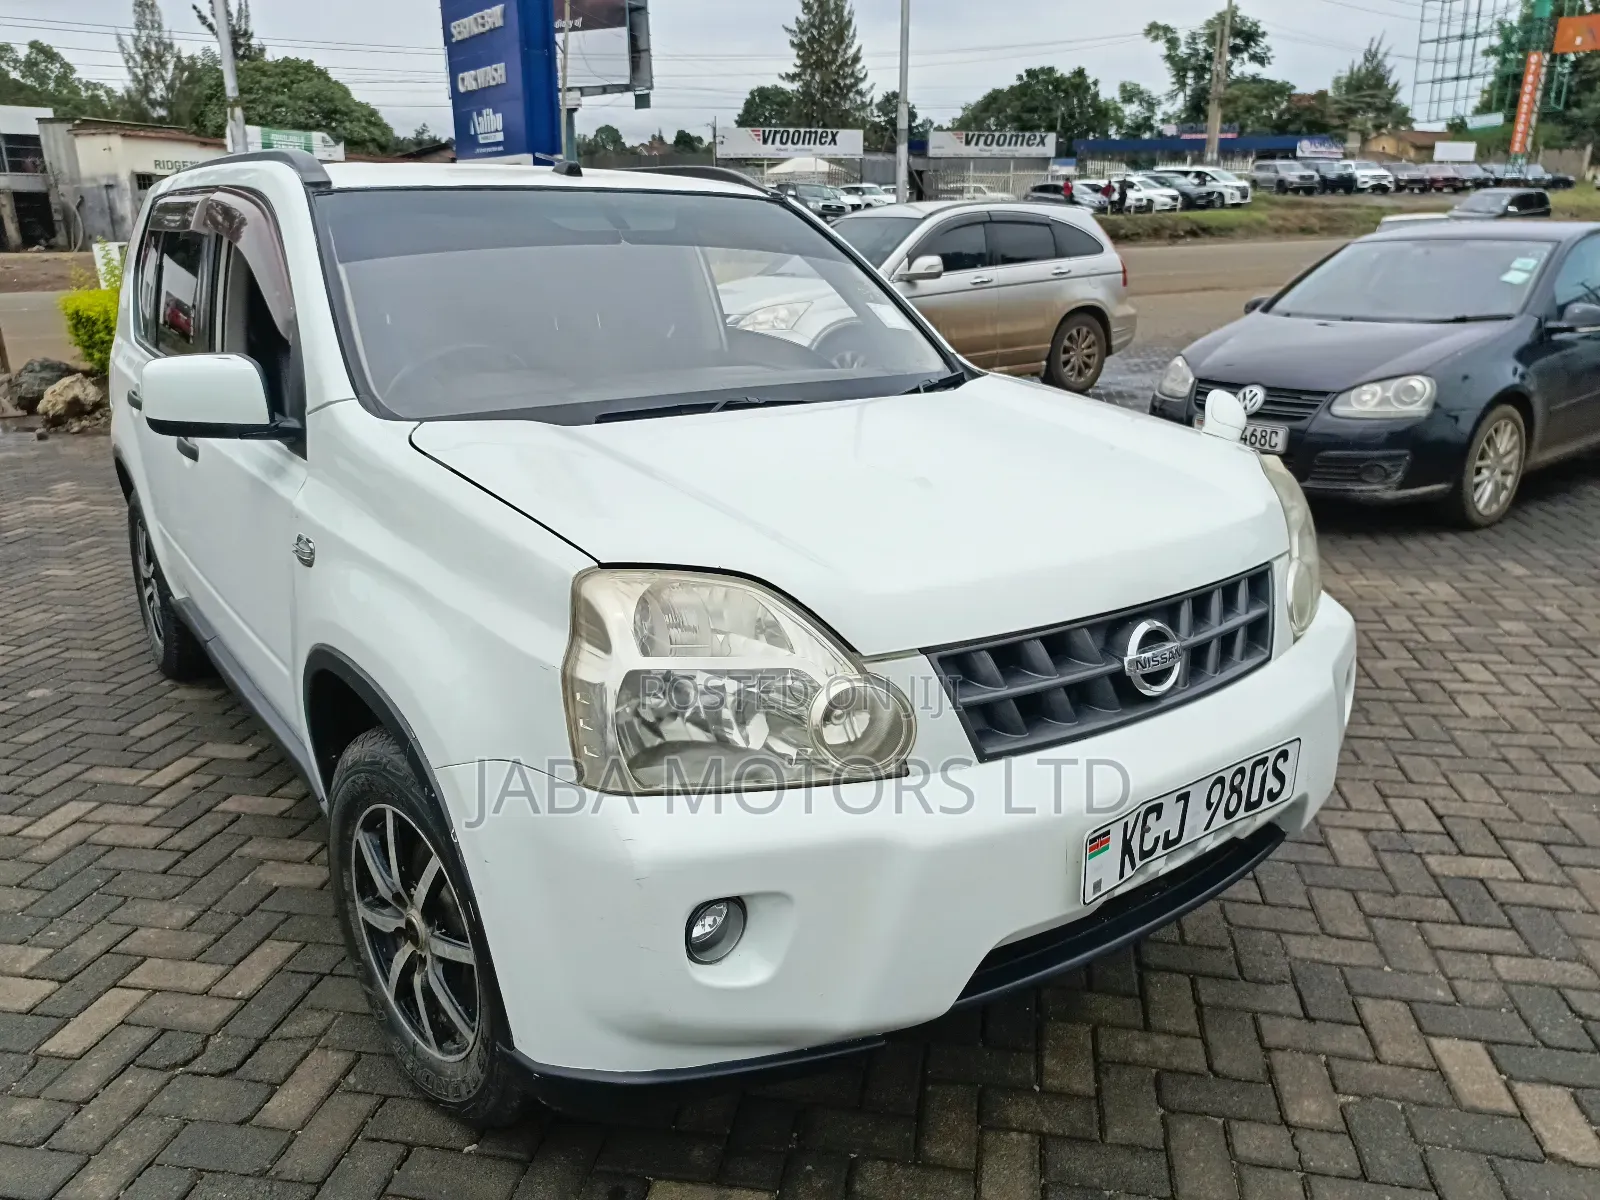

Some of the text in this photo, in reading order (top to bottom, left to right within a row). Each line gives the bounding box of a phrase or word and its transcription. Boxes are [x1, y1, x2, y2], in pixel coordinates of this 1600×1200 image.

[477, 62, 507, 88] WASH
[761, 129, 839, 146] vroomex
[964, 132, 1048, 147] vroomex
[1240, 427, 1279, 449] 468C
[1136, 645, 1182, 671] NISSAN
[1118, 748, 1290, 881] KCJ 980S
